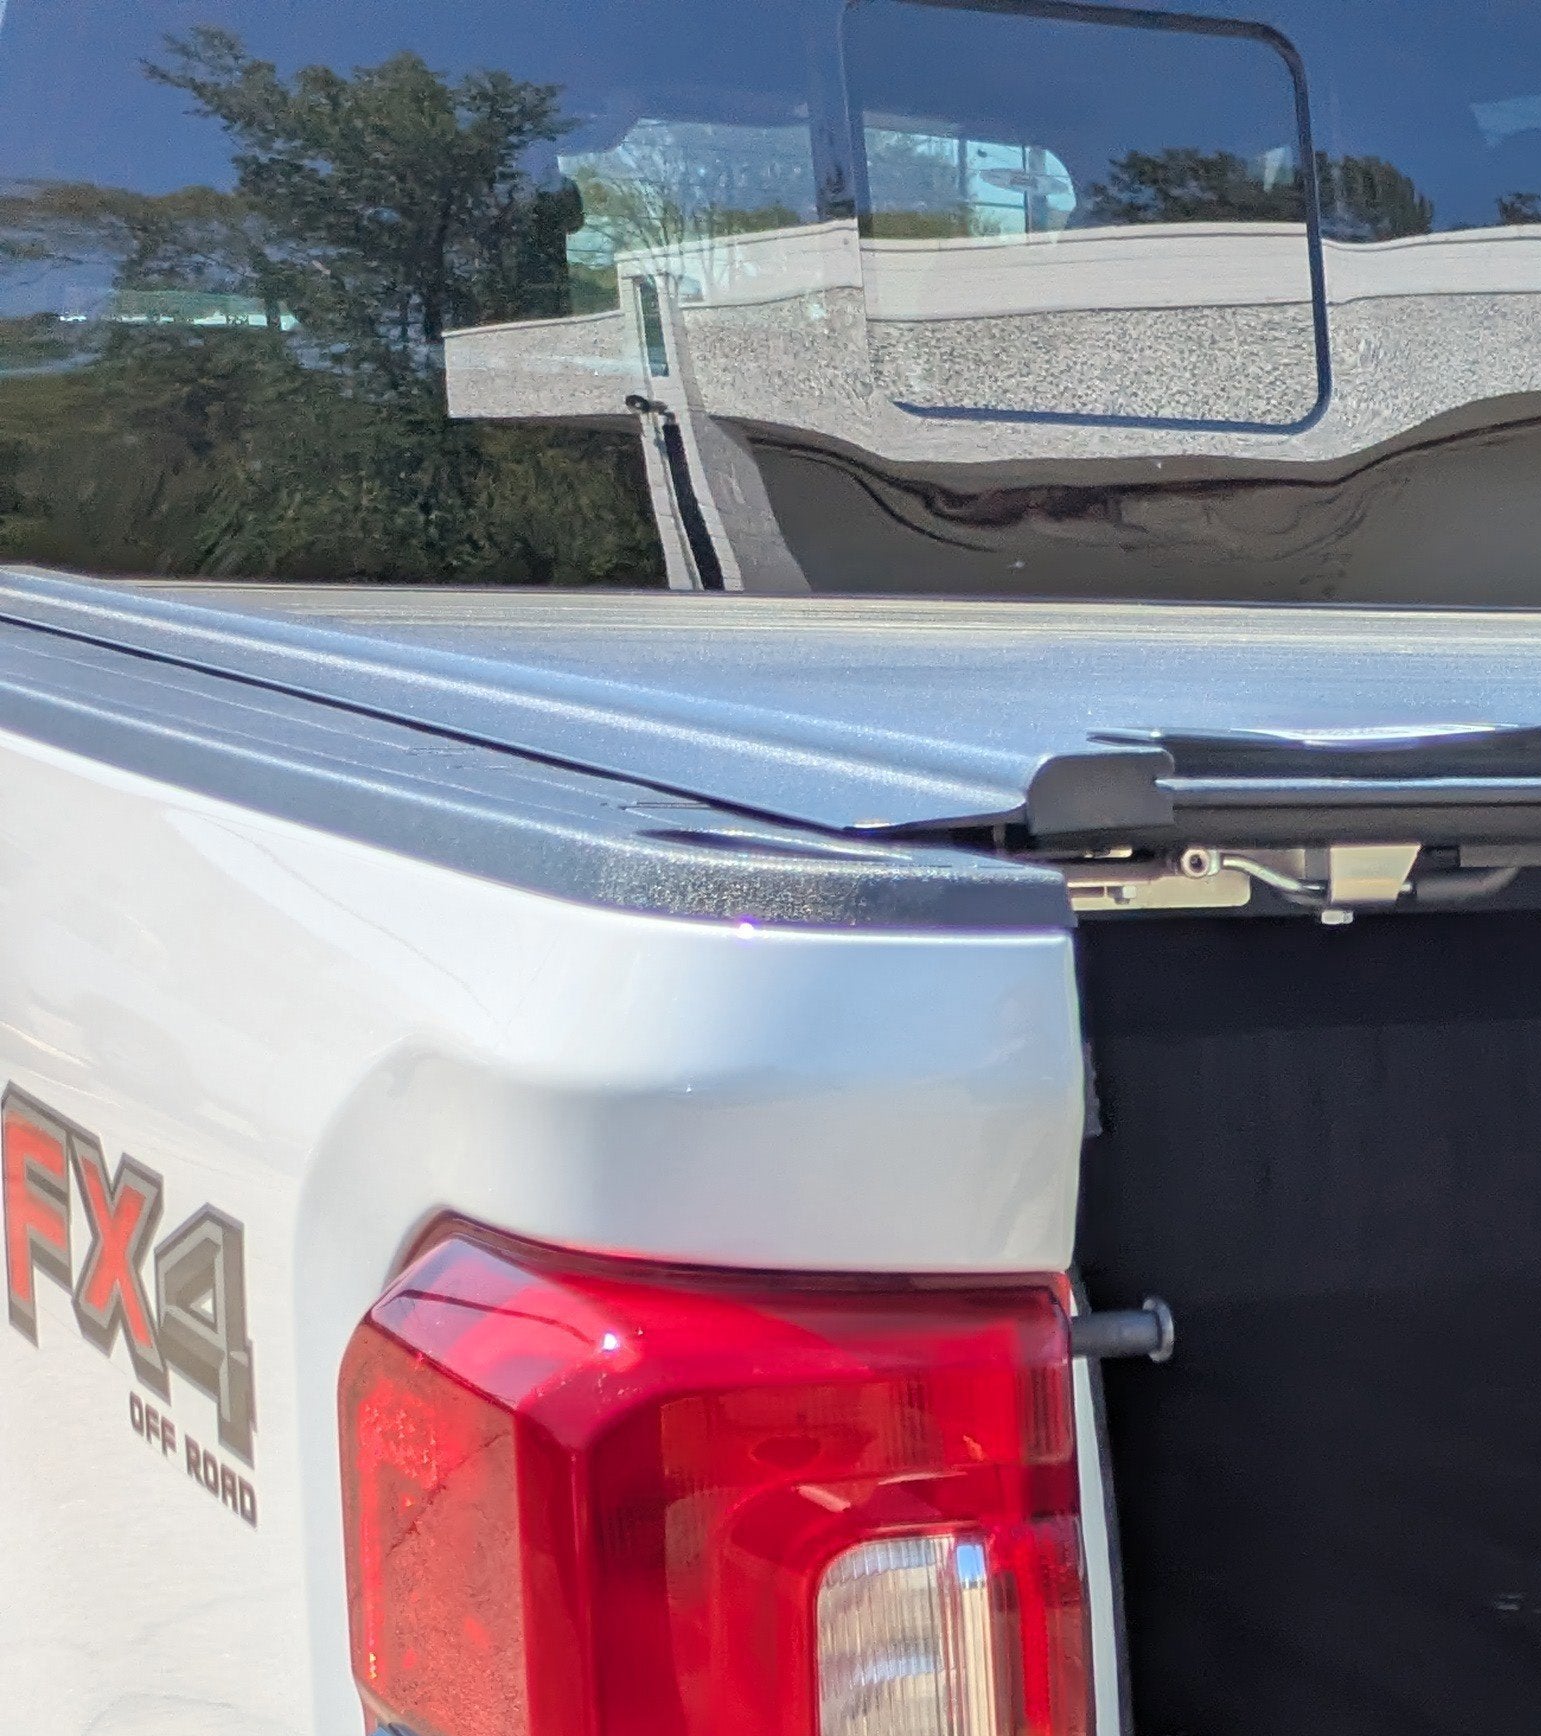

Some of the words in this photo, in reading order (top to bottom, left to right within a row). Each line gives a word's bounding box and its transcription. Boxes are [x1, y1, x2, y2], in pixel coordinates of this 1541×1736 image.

[2, 1079, 258, 1471] FX4
[129, 1390, 178, 1458] OFF
[184, 1433, 258, 1530] ROAD
